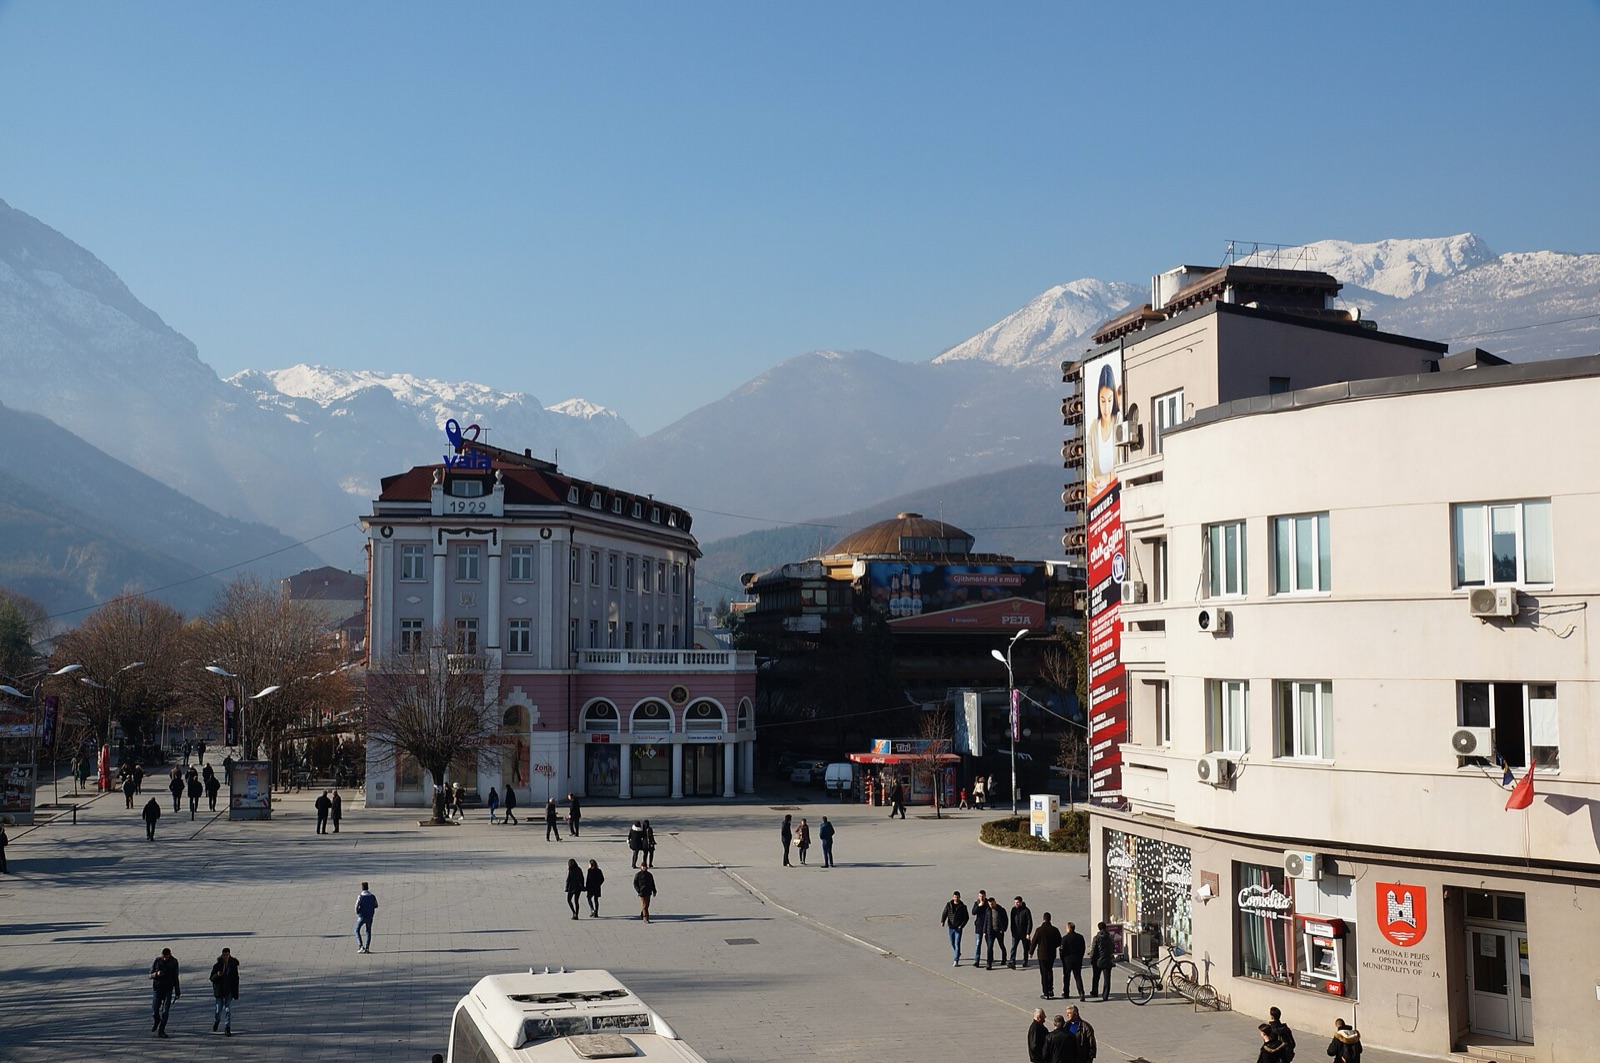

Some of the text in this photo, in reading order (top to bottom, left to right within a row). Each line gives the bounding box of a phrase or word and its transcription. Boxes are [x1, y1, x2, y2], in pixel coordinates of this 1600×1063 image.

[442, 448, 492, 469] vala
[450, 501, 487, 513] 1929
[1001, 615, 1032, 625] PEJA
[896, 743, 911, 752] Tini
[1255, 909, 1278, 919] HOME
[1371, 947, 1403, 958] KOMUNA
[1362, 961, 1410, 974] MUNICIPALITY
[1412, 968, 1423, 976] OF
